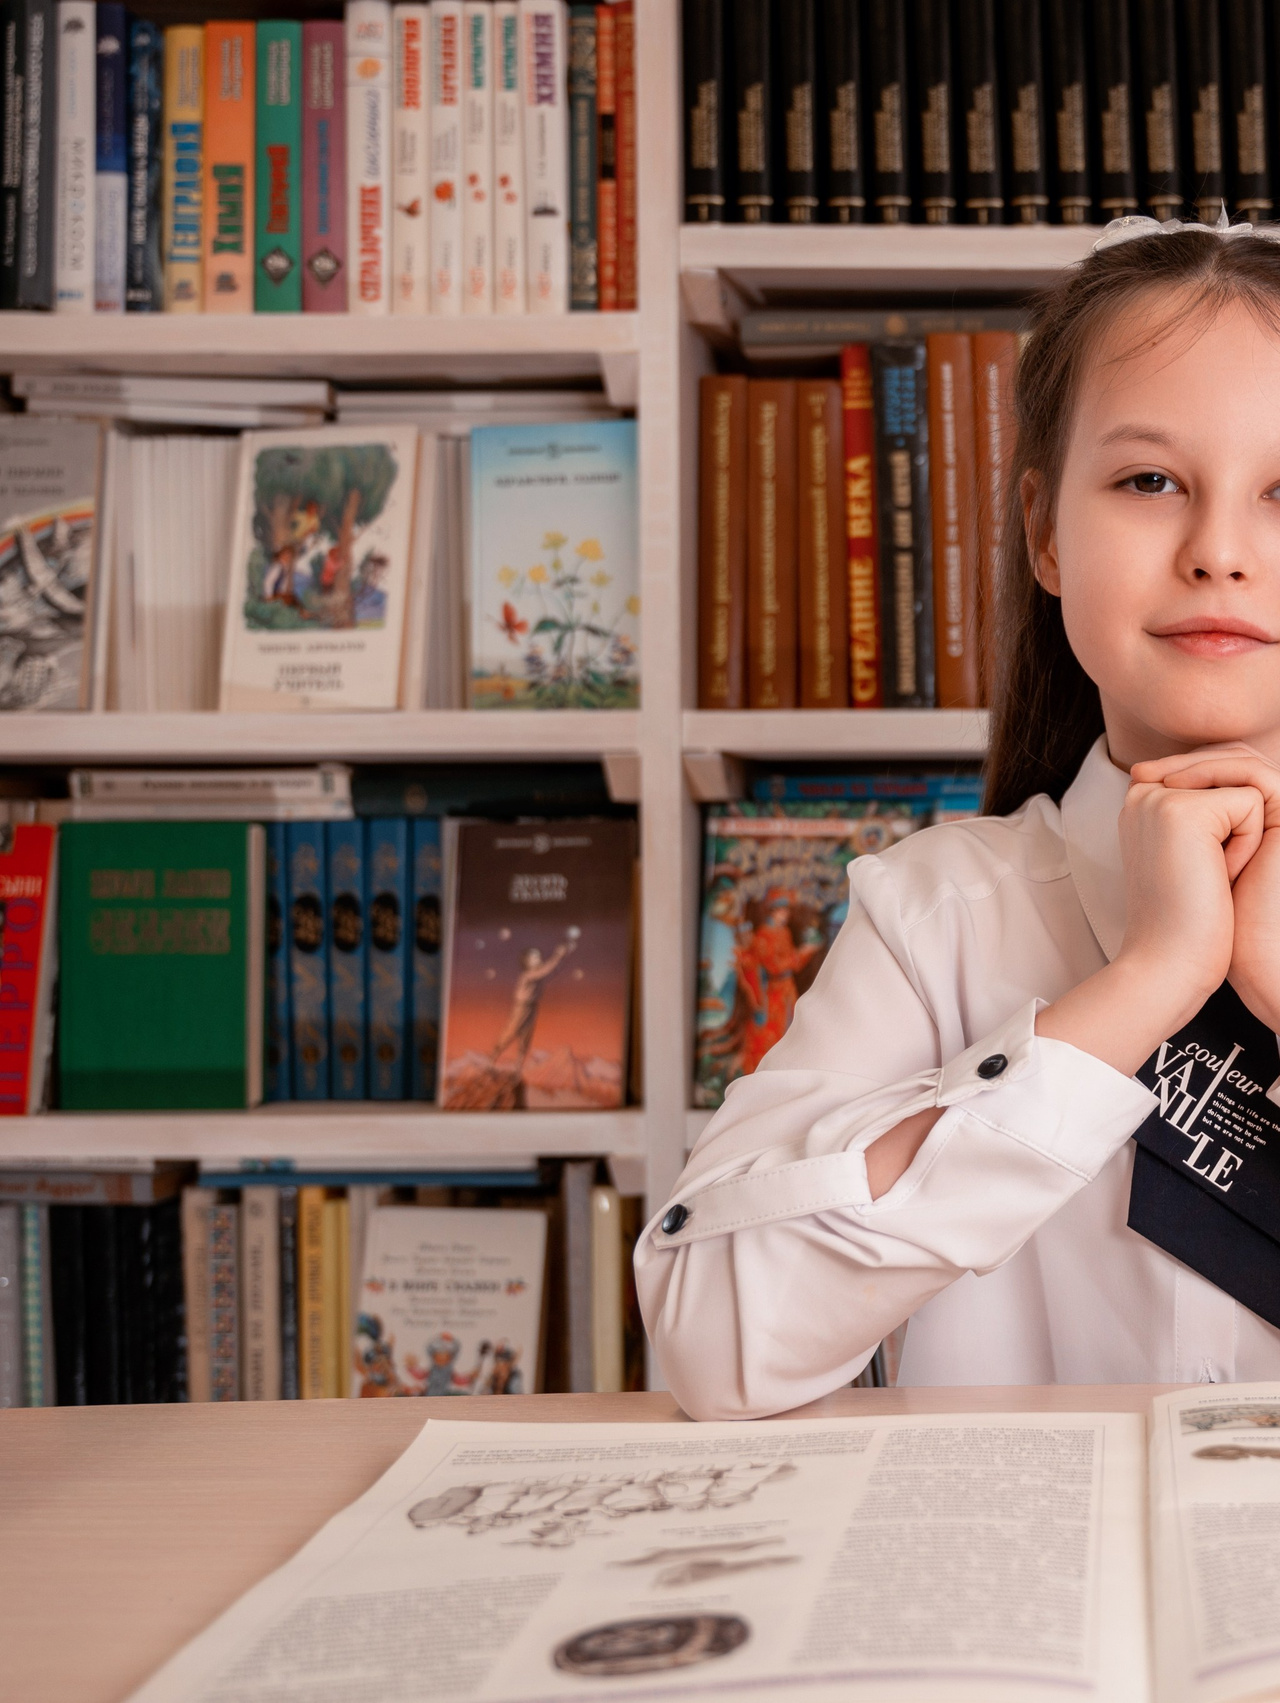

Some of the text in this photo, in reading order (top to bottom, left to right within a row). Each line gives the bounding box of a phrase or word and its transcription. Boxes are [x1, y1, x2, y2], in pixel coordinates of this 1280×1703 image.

[533, 13, 556, 106] ХИМИЯ
[358, 184, 383, 303] СПРАВОЧНИК
[845, 454, 878, 702] СРЕДНИЕ ВЕКА
[1185, 1042, 1263, 1097] couleur
[1207, 1108, 1267, 1146] doing we may be down
[1212, 1100, 1263, 1132] things most worth
[1217, 1091, 1235, 1106] things
[1237, 1103, 1245, 1111] in
[1246, 1107, 1259, 1120] life
[1260, 1116, 1271, 1126] are
[1202, 1116, 1256, 1151] but we are not out
